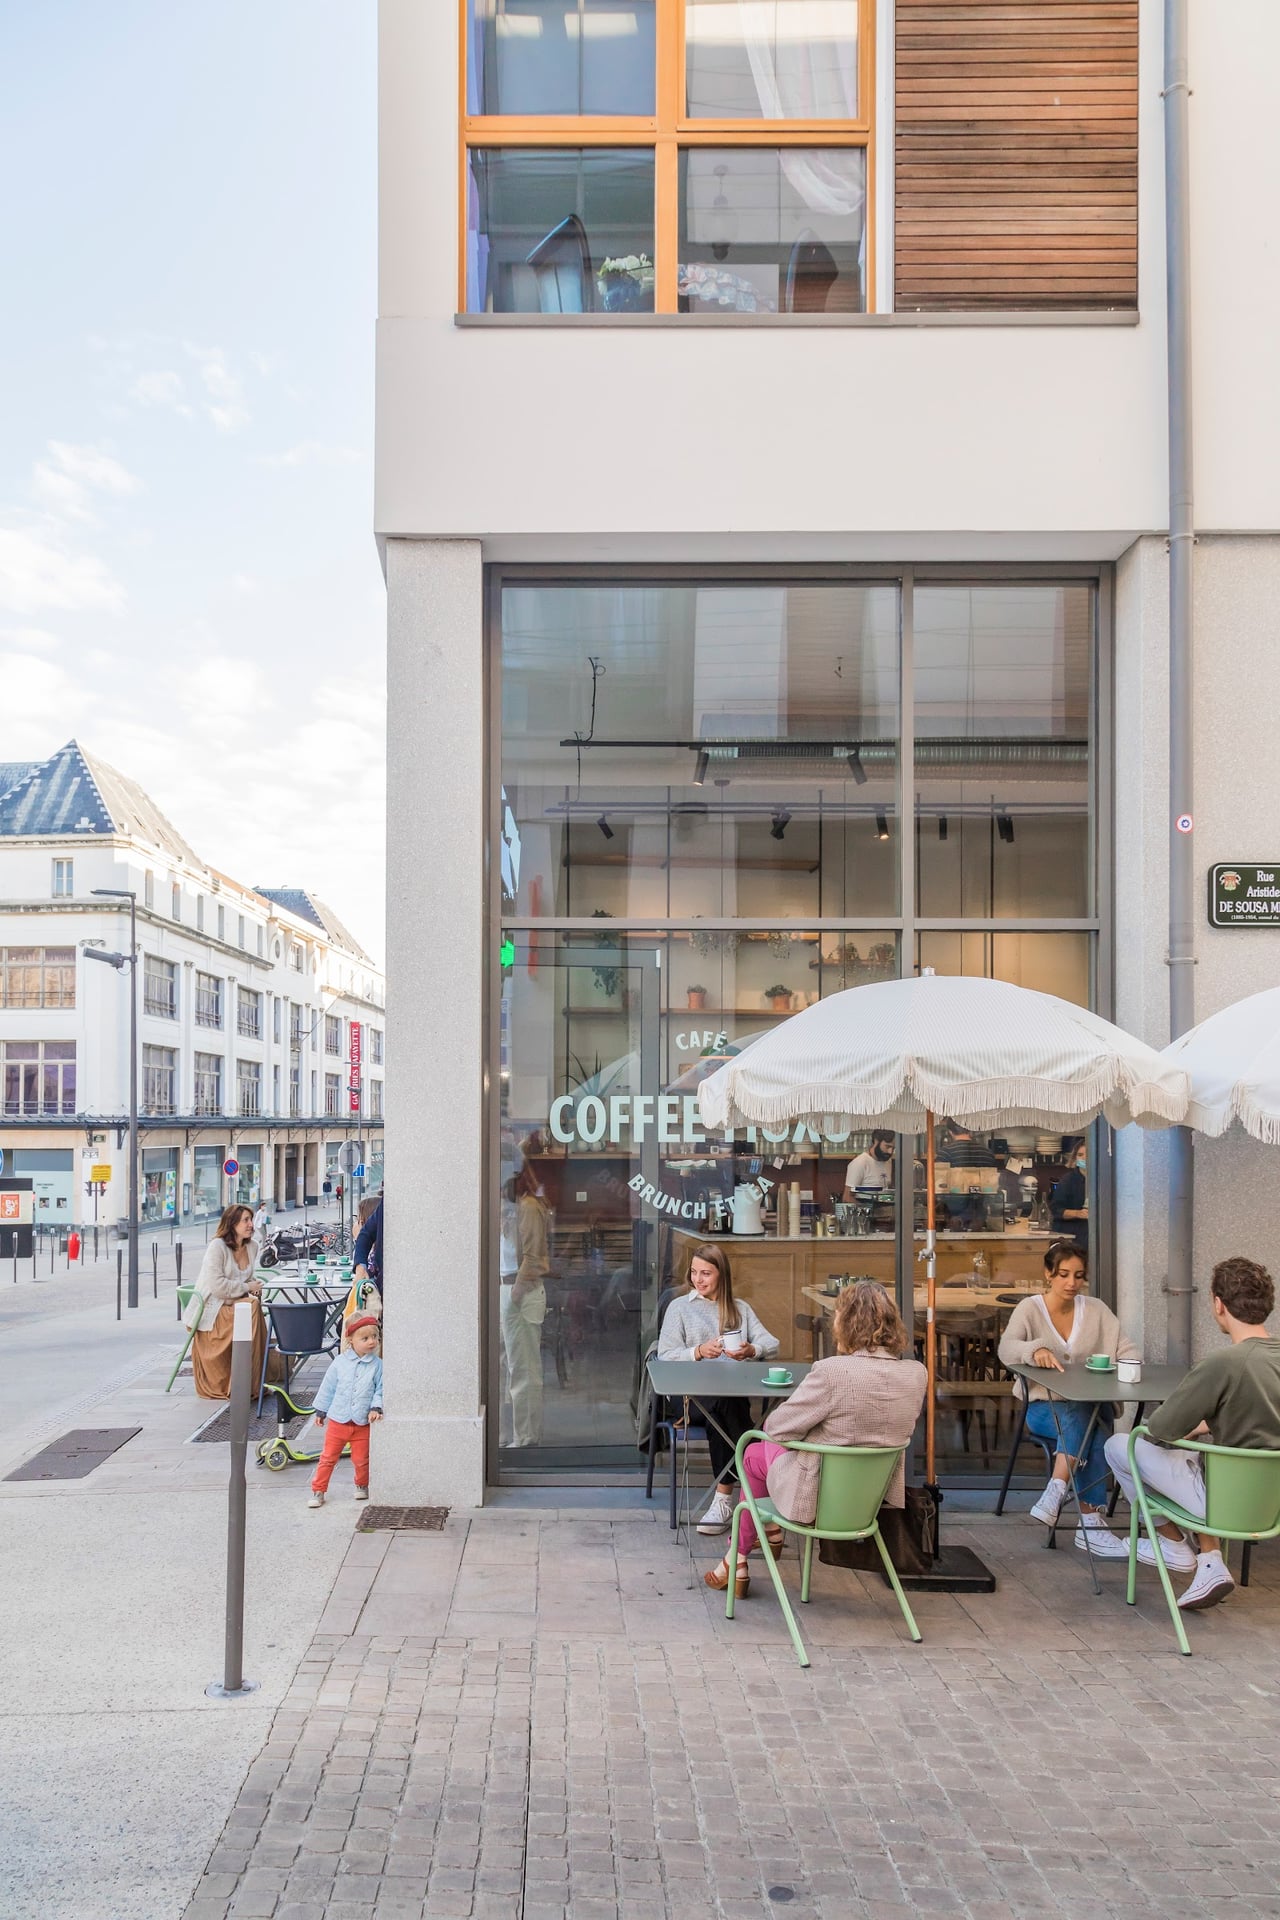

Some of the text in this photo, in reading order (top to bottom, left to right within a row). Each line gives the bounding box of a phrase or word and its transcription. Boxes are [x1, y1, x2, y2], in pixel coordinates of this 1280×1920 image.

[1256, 870, 1274, 882] Rue
[1219, 901, 1234, 913] DE
[1235, 901, 1269, 913] SOUSA
[675, 1030, 728, 1052] CAFÉ
[549, 1095, 706, 1143] COFFEE
[627, 1173, 707, 1219] BRUNCH
[714, 1195, 739, 1218] ET
